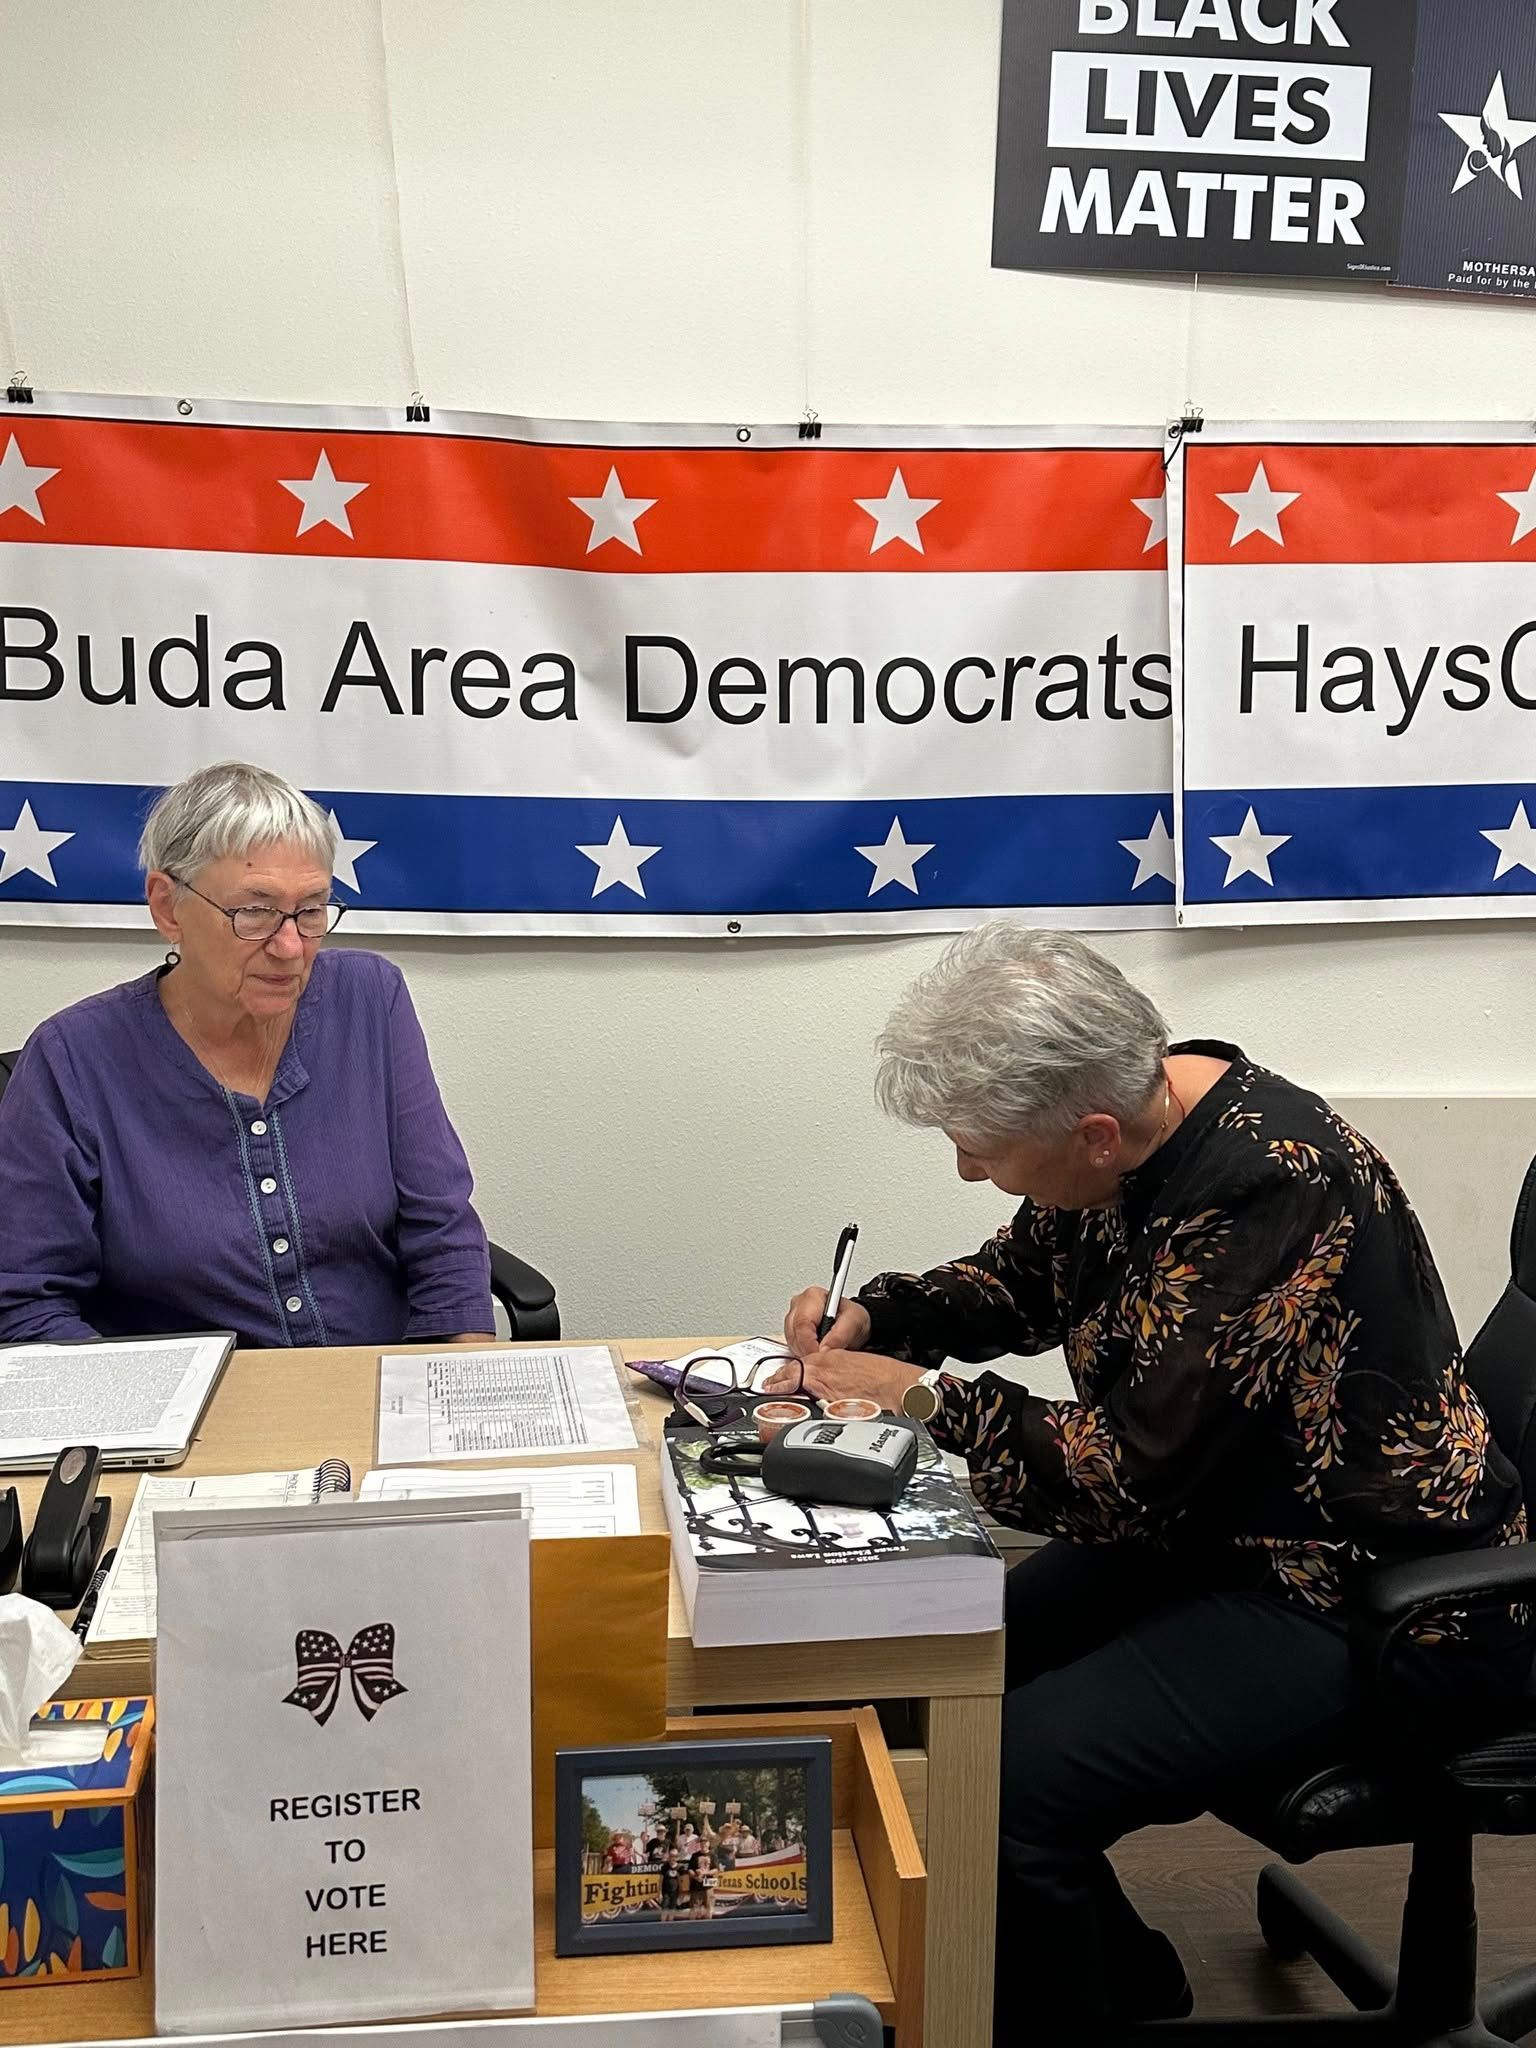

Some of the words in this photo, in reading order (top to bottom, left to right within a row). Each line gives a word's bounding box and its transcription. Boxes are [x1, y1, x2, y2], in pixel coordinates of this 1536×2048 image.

[1085, 67, 1331, 146] LIVES
[1039, 166, 1366, 246] MATTER
[1447, 273, 1473, 284] Paid
[1477, 275, 1492, 285] for
[1496, 277, 1510, 289] by
[1513, 279, 1531, 289] the
[0, 606, 286, 712] Buda
[320, 621, 579, 722] Area
[625, 633, 1172, 726] Democrats
[823, 1549, 872, 1558] Election
[269, 1788, 422, 1822] REGISTER
[324, 1838, 366, 1865] TO
[745, 1872, 807, 1891] Schools
[305, 1883, 387, 1912] VOTE
[305, 1930, 387, 1959] HERE
